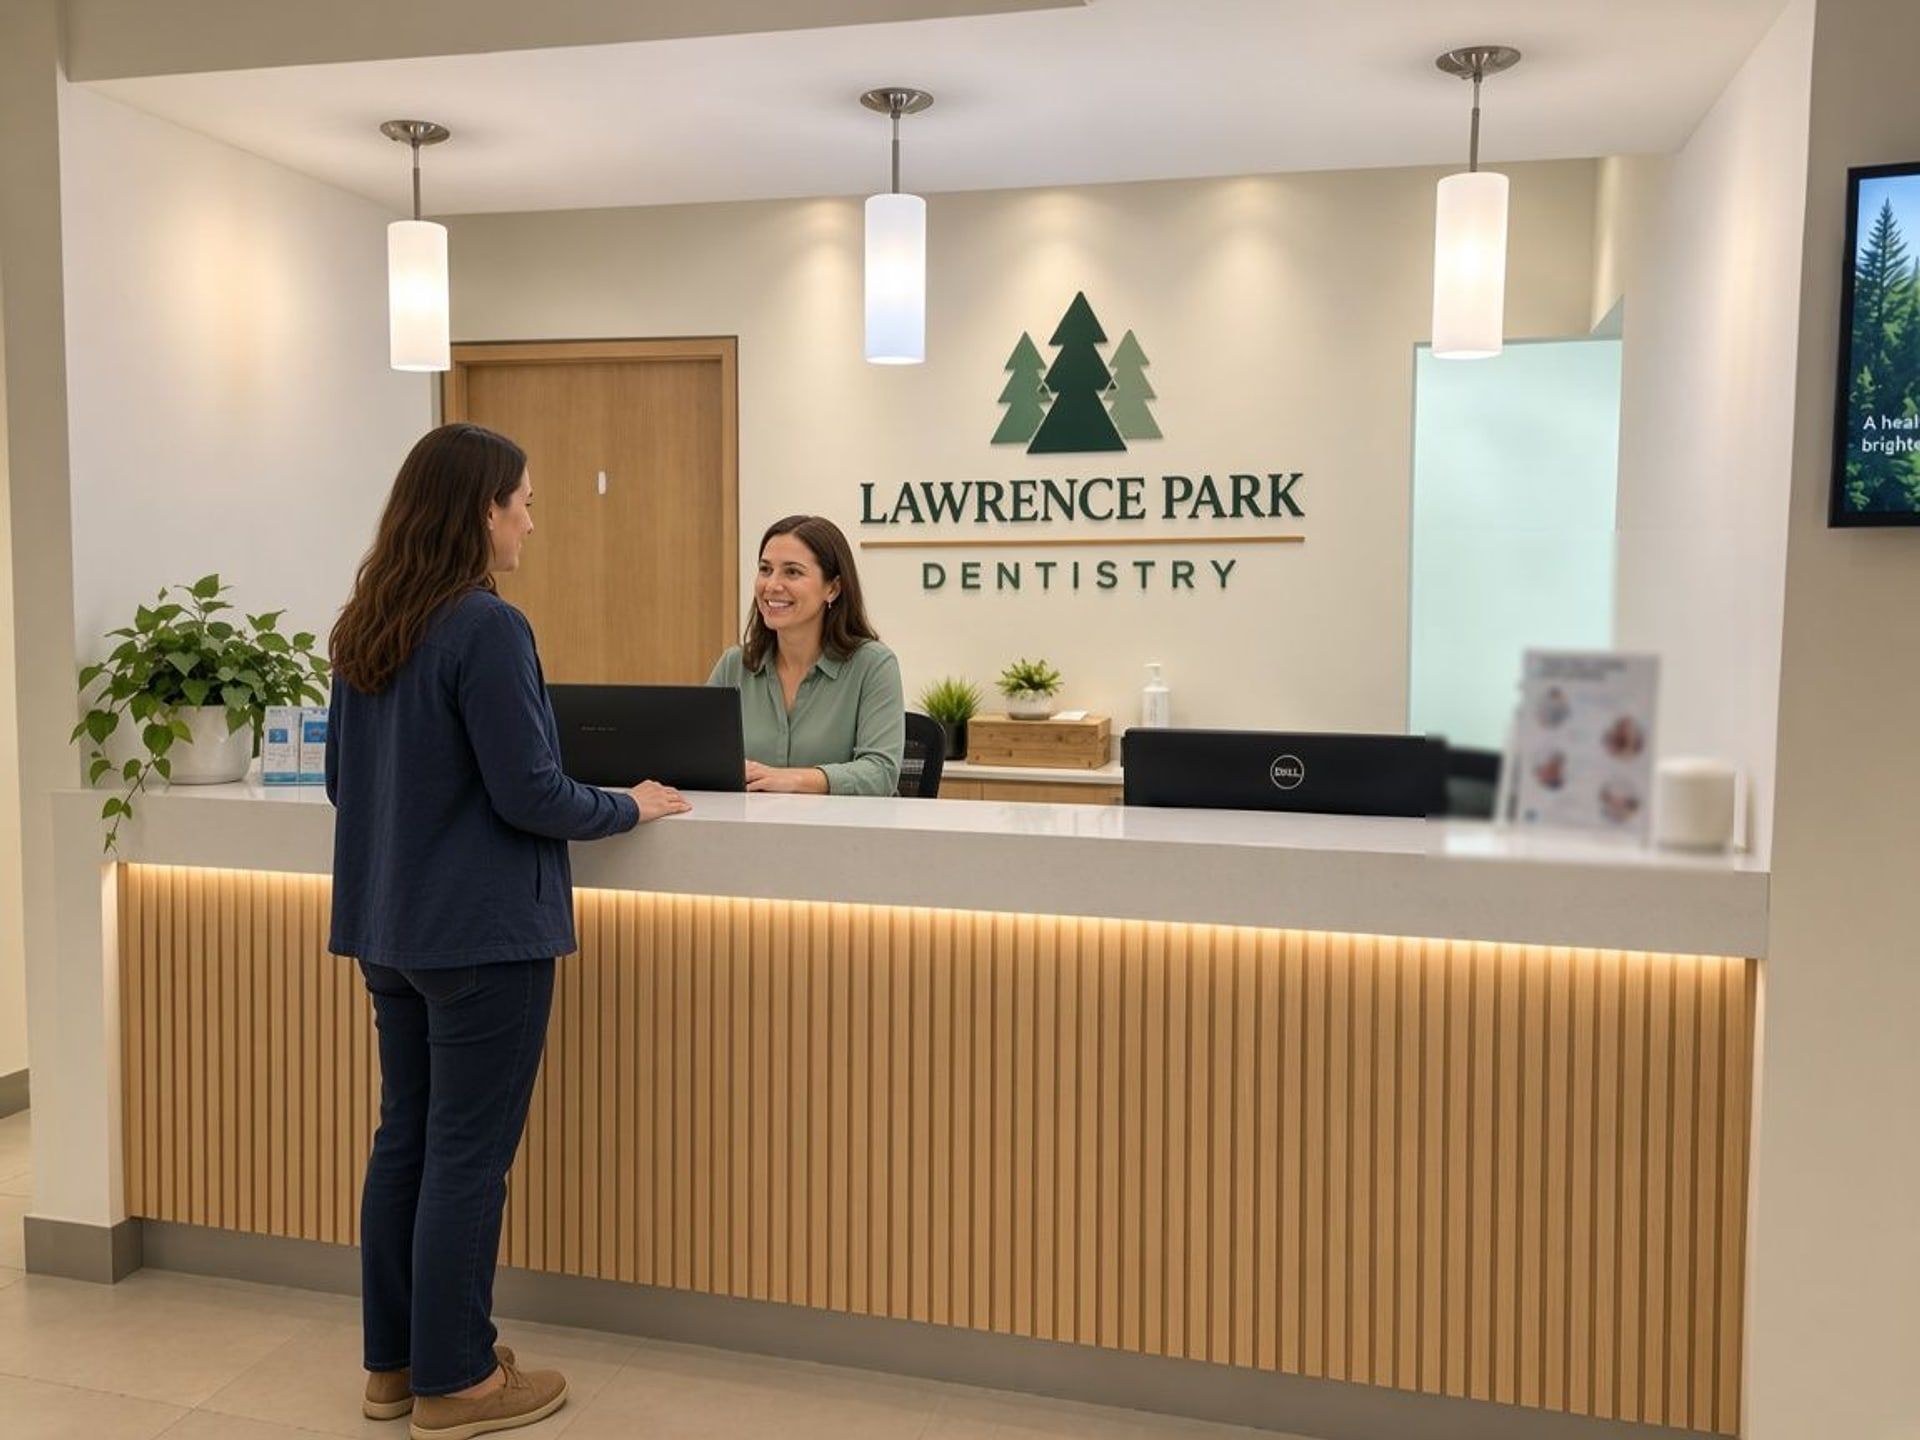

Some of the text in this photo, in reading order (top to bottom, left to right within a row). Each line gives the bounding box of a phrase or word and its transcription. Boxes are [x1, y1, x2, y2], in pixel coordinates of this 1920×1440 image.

[1863, 415, 1877, 430] A
[860, 472, 1305, 525] LAWRENCE PARK
[922, 559, 1237, 590] DENTISTRY
